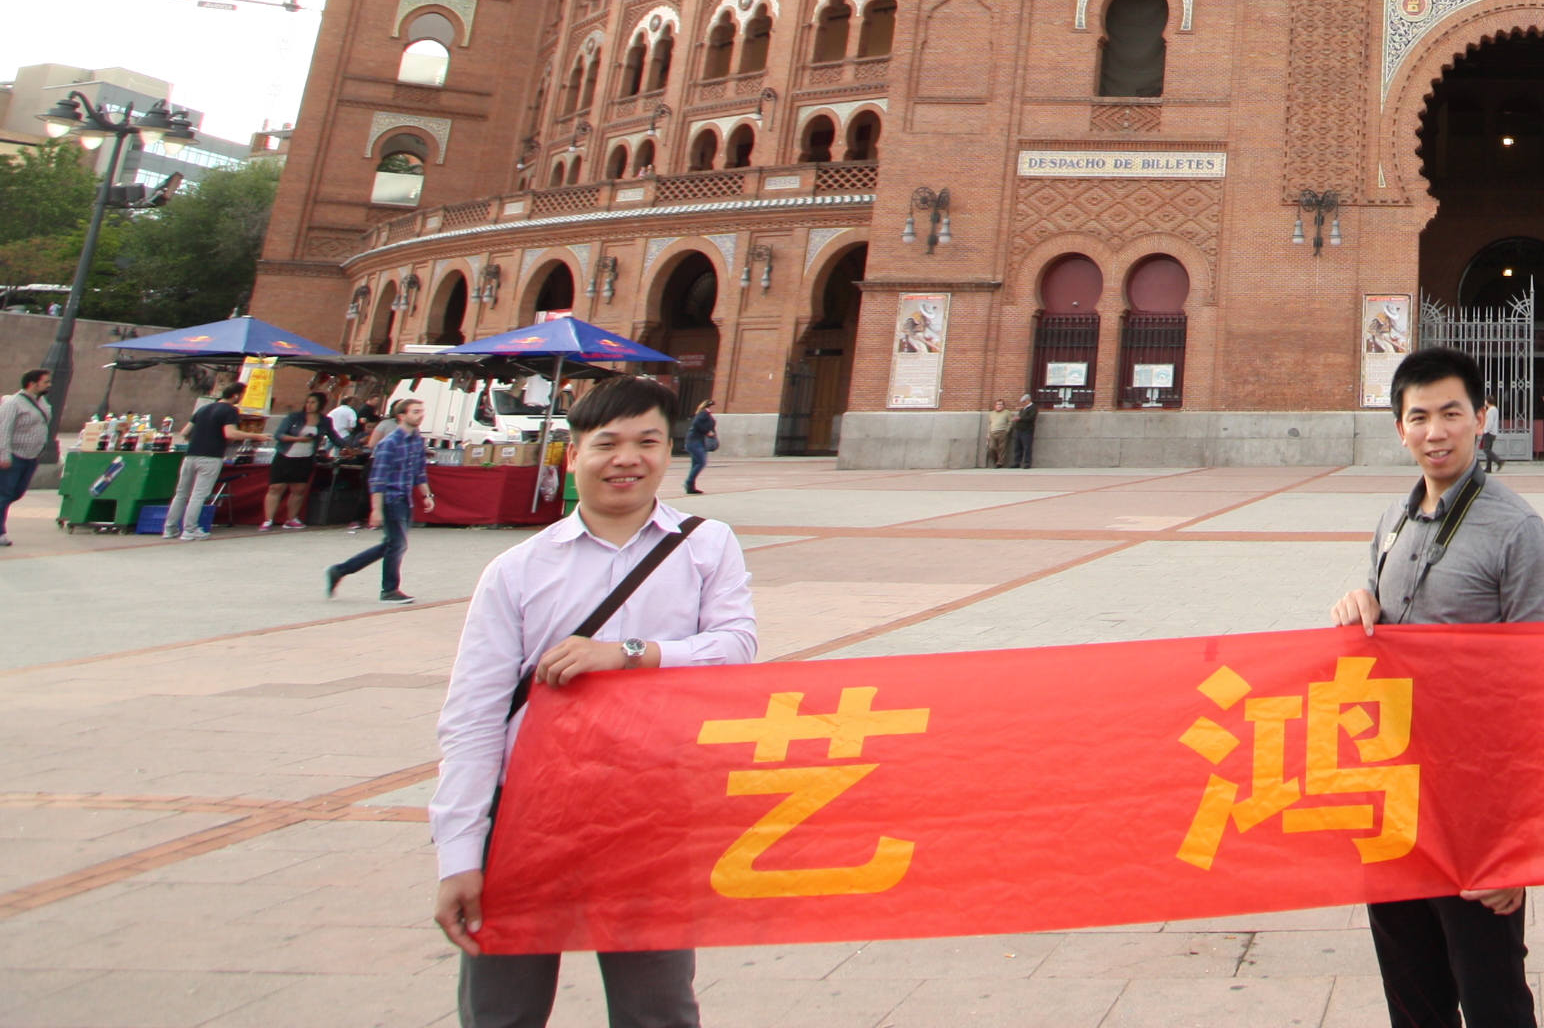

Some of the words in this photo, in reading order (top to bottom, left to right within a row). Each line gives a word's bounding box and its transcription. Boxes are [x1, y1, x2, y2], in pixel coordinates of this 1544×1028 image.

[1028, 157, 1106, 170] DESPACHO
[1113, 158, 1134, 170] DE
[1141, 158, 1215, 171] BILLETES
